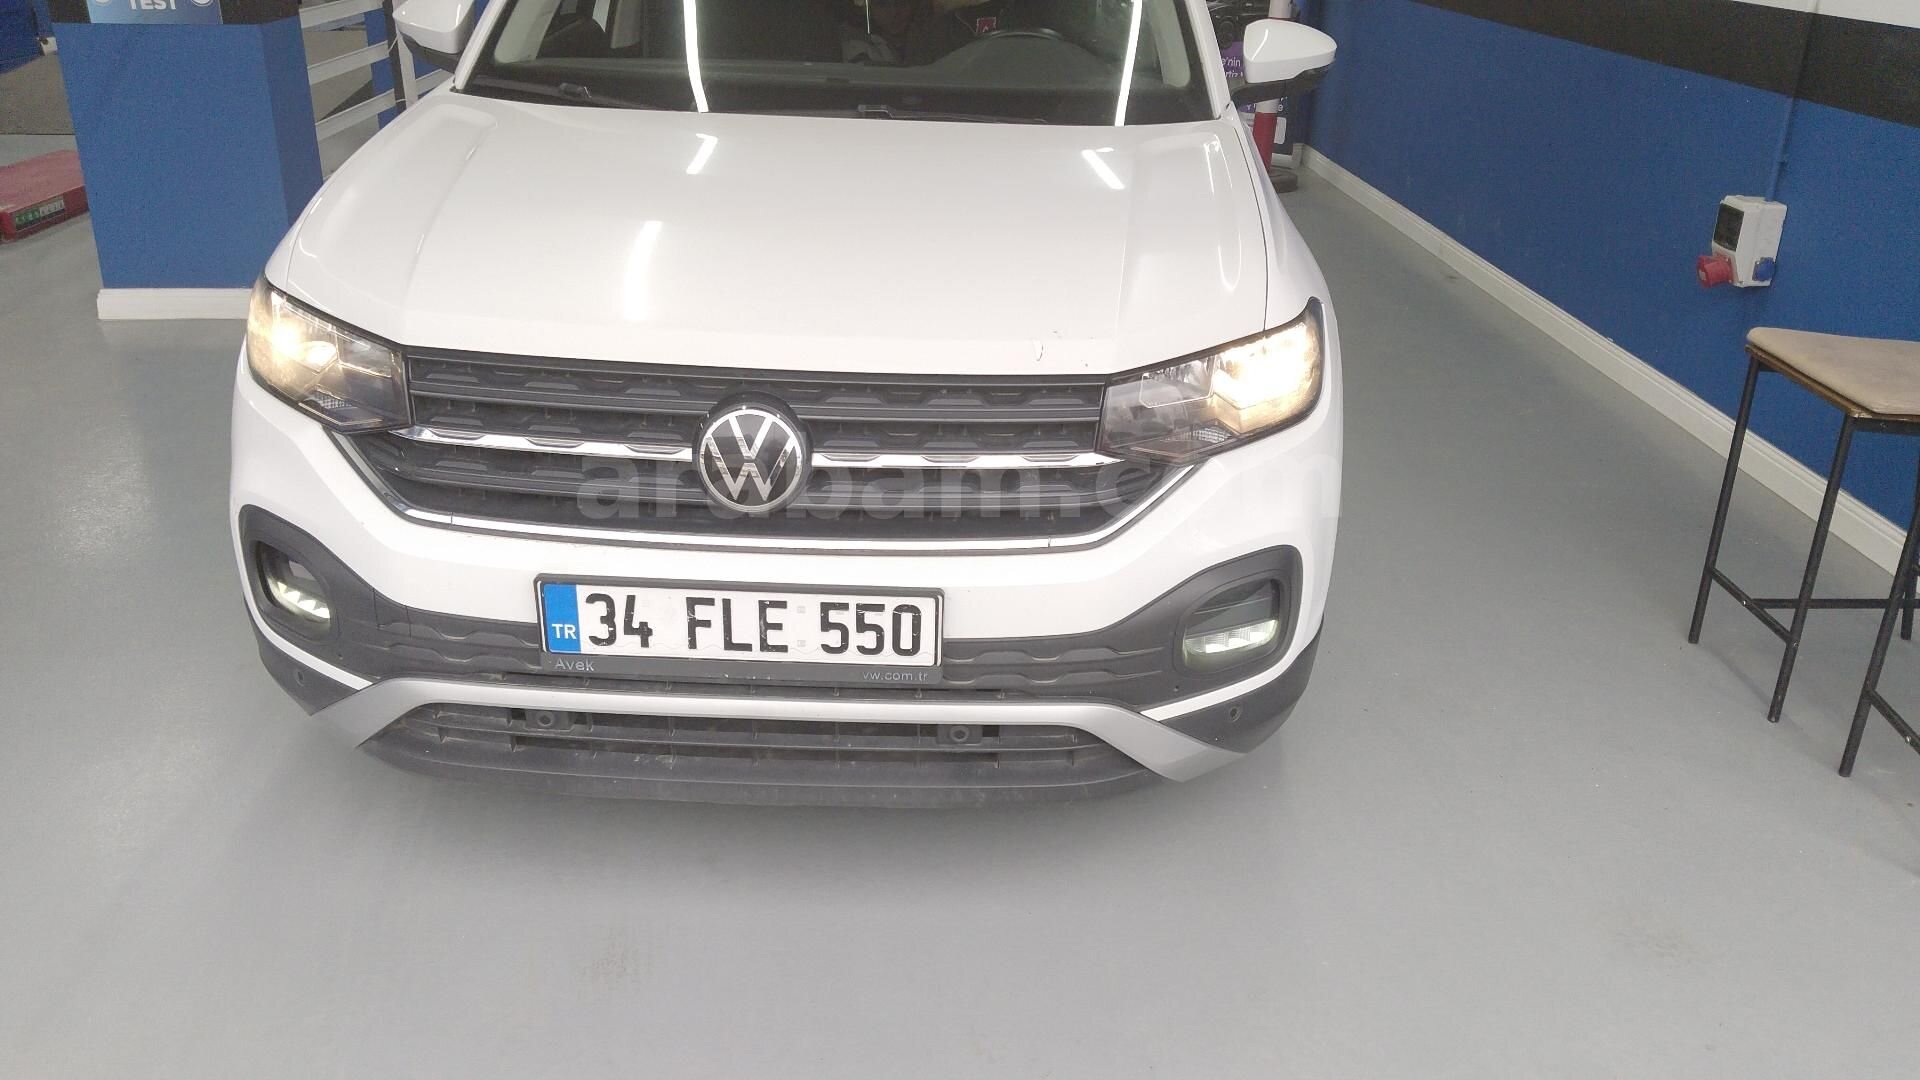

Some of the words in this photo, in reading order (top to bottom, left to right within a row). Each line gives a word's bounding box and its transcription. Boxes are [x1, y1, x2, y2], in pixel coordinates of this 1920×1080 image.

[552, 623, 577, 640] TR
[585, 592, 653, 648] 34
[686, 596, 788, 653] FLE
[820, 601, 922, 656] 550
[554, 657, 595, 672] Avek
[862, 670, 928, 682] vw.com.tr
